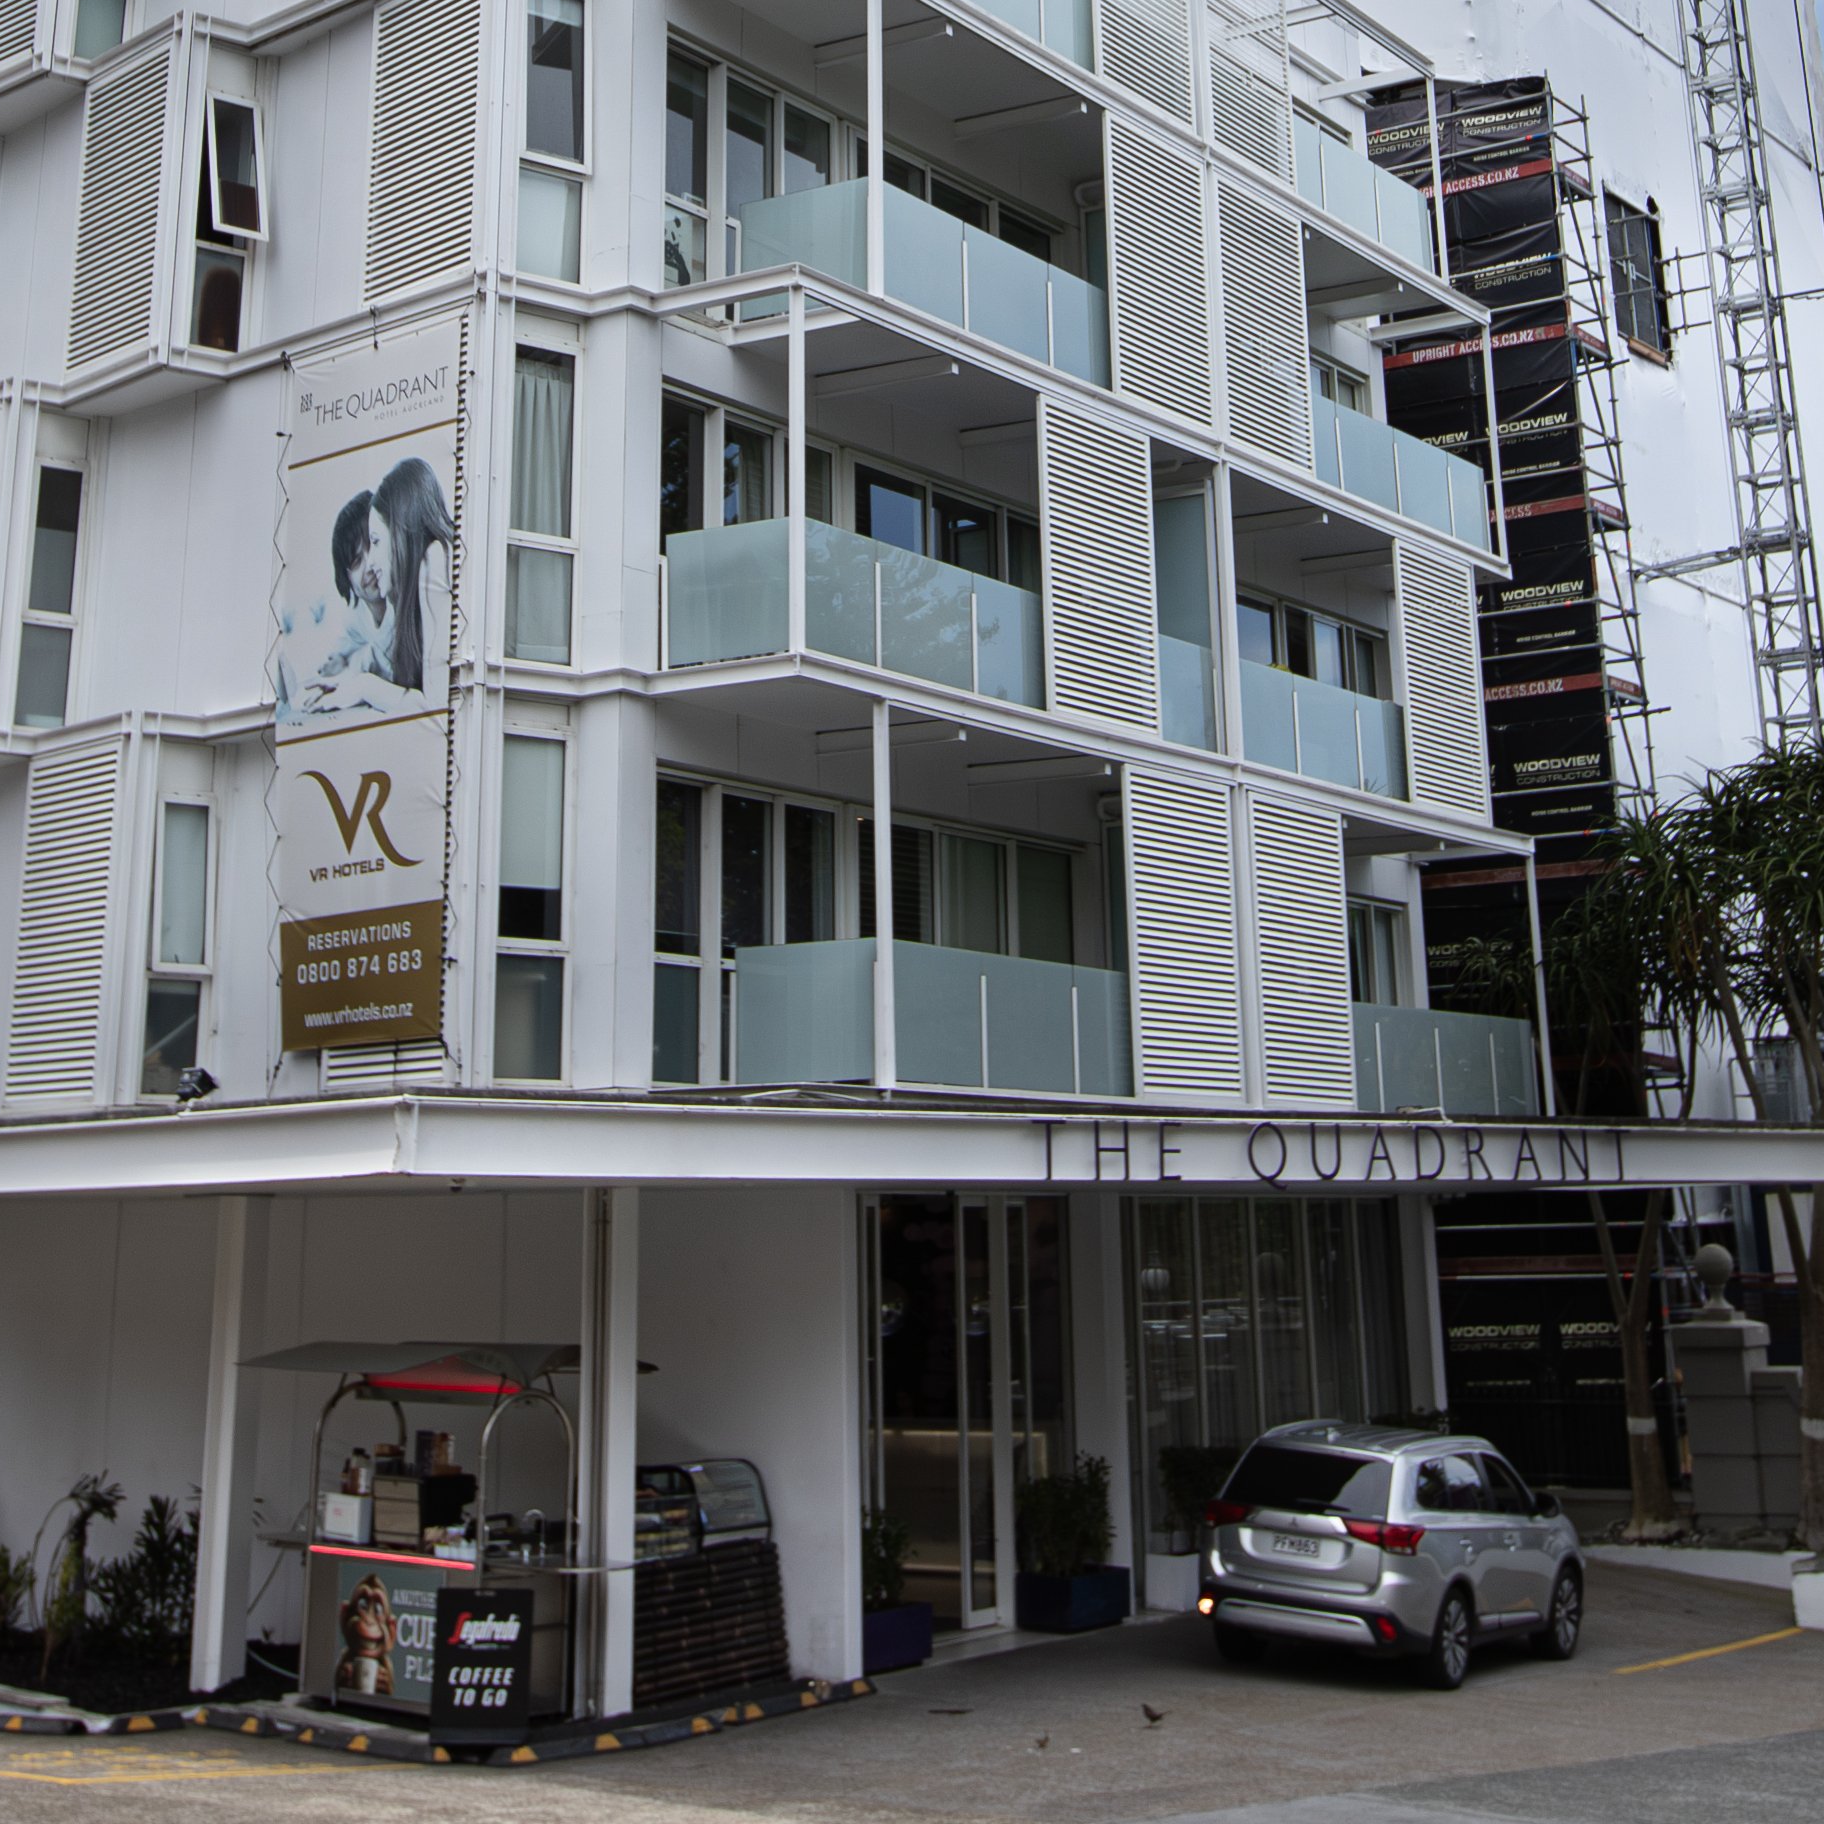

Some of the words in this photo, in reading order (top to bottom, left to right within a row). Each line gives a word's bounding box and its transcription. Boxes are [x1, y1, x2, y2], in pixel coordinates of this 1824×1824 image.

[1461, 106, 1542, 128] WOODVIEW
[1463, 119, 1541, 138] CONSTRUCTION
[1445, 166, 1520, 193] ACCESS.CO.NZ
[1475, 266, 1552, 291] CONSTRUCTION
[1412, 343, 1456, 363] UPRIGHT
[314, 399, 344, 426] THE
[345, 366, 449, 419] QUADRANT
[1501, 580, 1584, 602] WOODVIEW
[1485, 679, 1564, 702] ACCESS.CO.NZ
[1513, 753, 1601, 773] WOODVIEW
[1516, 769, 1601, 785] CONSTRUCTION
[295, 770, 425, 868] VR
[309, 867, 329, 883] VR
[332, 858, 385, 880] HOTELS
[307, 921, 412, 953] RESERVATIONS
[297, 959, 341, 985] 0800
[347, 954, 381, 978] 874
[387, 949, 423, 974] 683
[304, 1001, 414, 1028] www.vrhotels.co.nz
[1031, 1119, 1184, 1182] THE
[1245, 1120, 1632, 1190] QUADRANT
[1448, 1324, 1541, 1338] WOODVIEW
[447, 1611, 521, 1645] Segafredo
[448, 1666, 515, 1686] COFFEE
[453, 1687, 476, 1707] TO
[481, 1687, 508, 1707] GO
